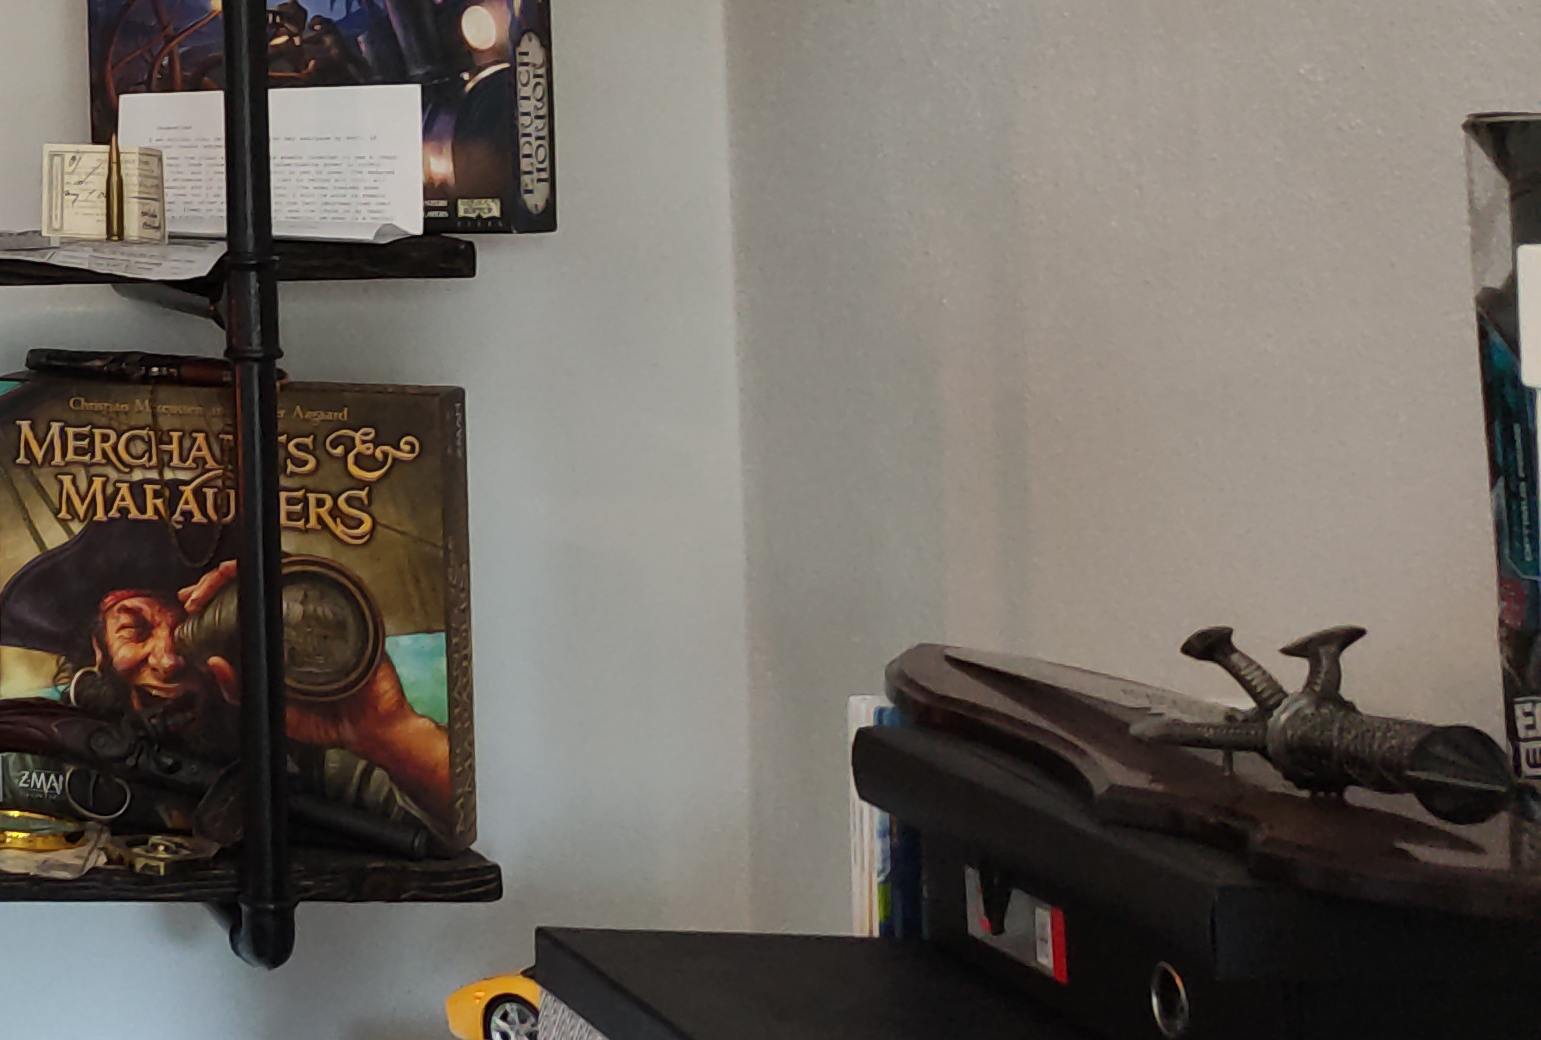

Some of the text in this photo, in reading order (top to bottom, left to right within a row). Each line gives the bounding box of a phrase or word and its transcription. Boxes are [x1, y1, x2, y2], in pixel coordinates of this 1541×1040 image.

[517, 51, 535, 196] ELDRITCH
[532, 58, 550, 183] HORROR
[324, 426, 421, 483] &
[56, 468, 374, 546] MARAUERS
